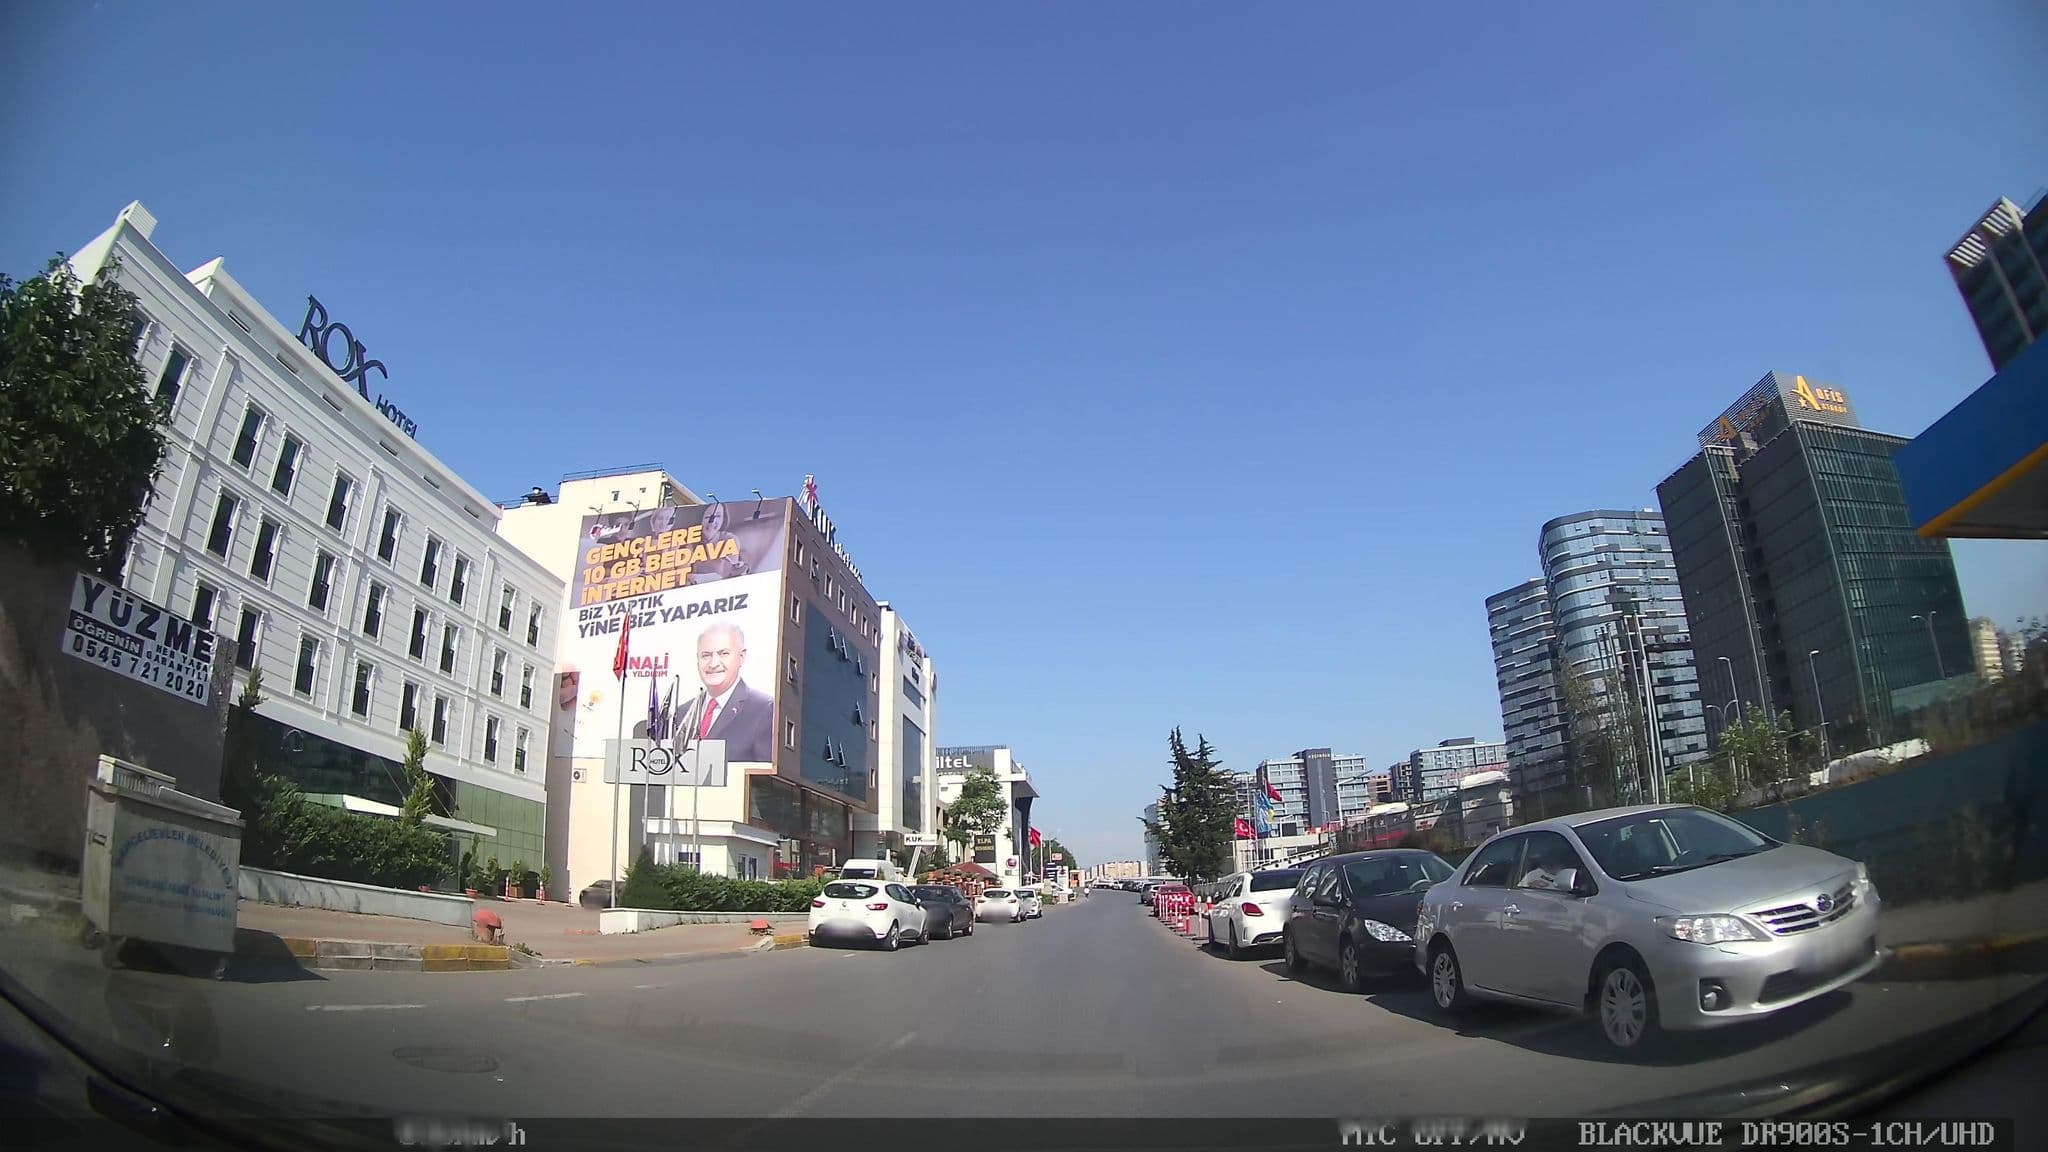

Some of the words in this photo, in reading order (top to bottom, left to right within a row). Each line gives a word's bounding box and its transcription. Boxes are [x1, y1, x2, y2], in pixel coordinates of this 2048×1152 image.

[296, 294, 388, 402] ROX
[583, 565, 606, 585] 10
[610, 557, 642, 580] GB
[646, 538, 740, 575] BEDAVA
[586, 525, 703, 565] GENÇLERE
[82, 575, 215, 664] YÜZME
[607, 593, 664, 617] YAPTIK
[660, 593, 749, 625] YAPARIZ
[73, 616, 140, 655] ÖĞRENİN
[156, 644, 175, 660] HER
[72, 634, 122, 668] 0545
[130, 657, 160, 683] 721
[628, 652, 670, 670] NALİ
[629, 747, 696, 776] ROX
